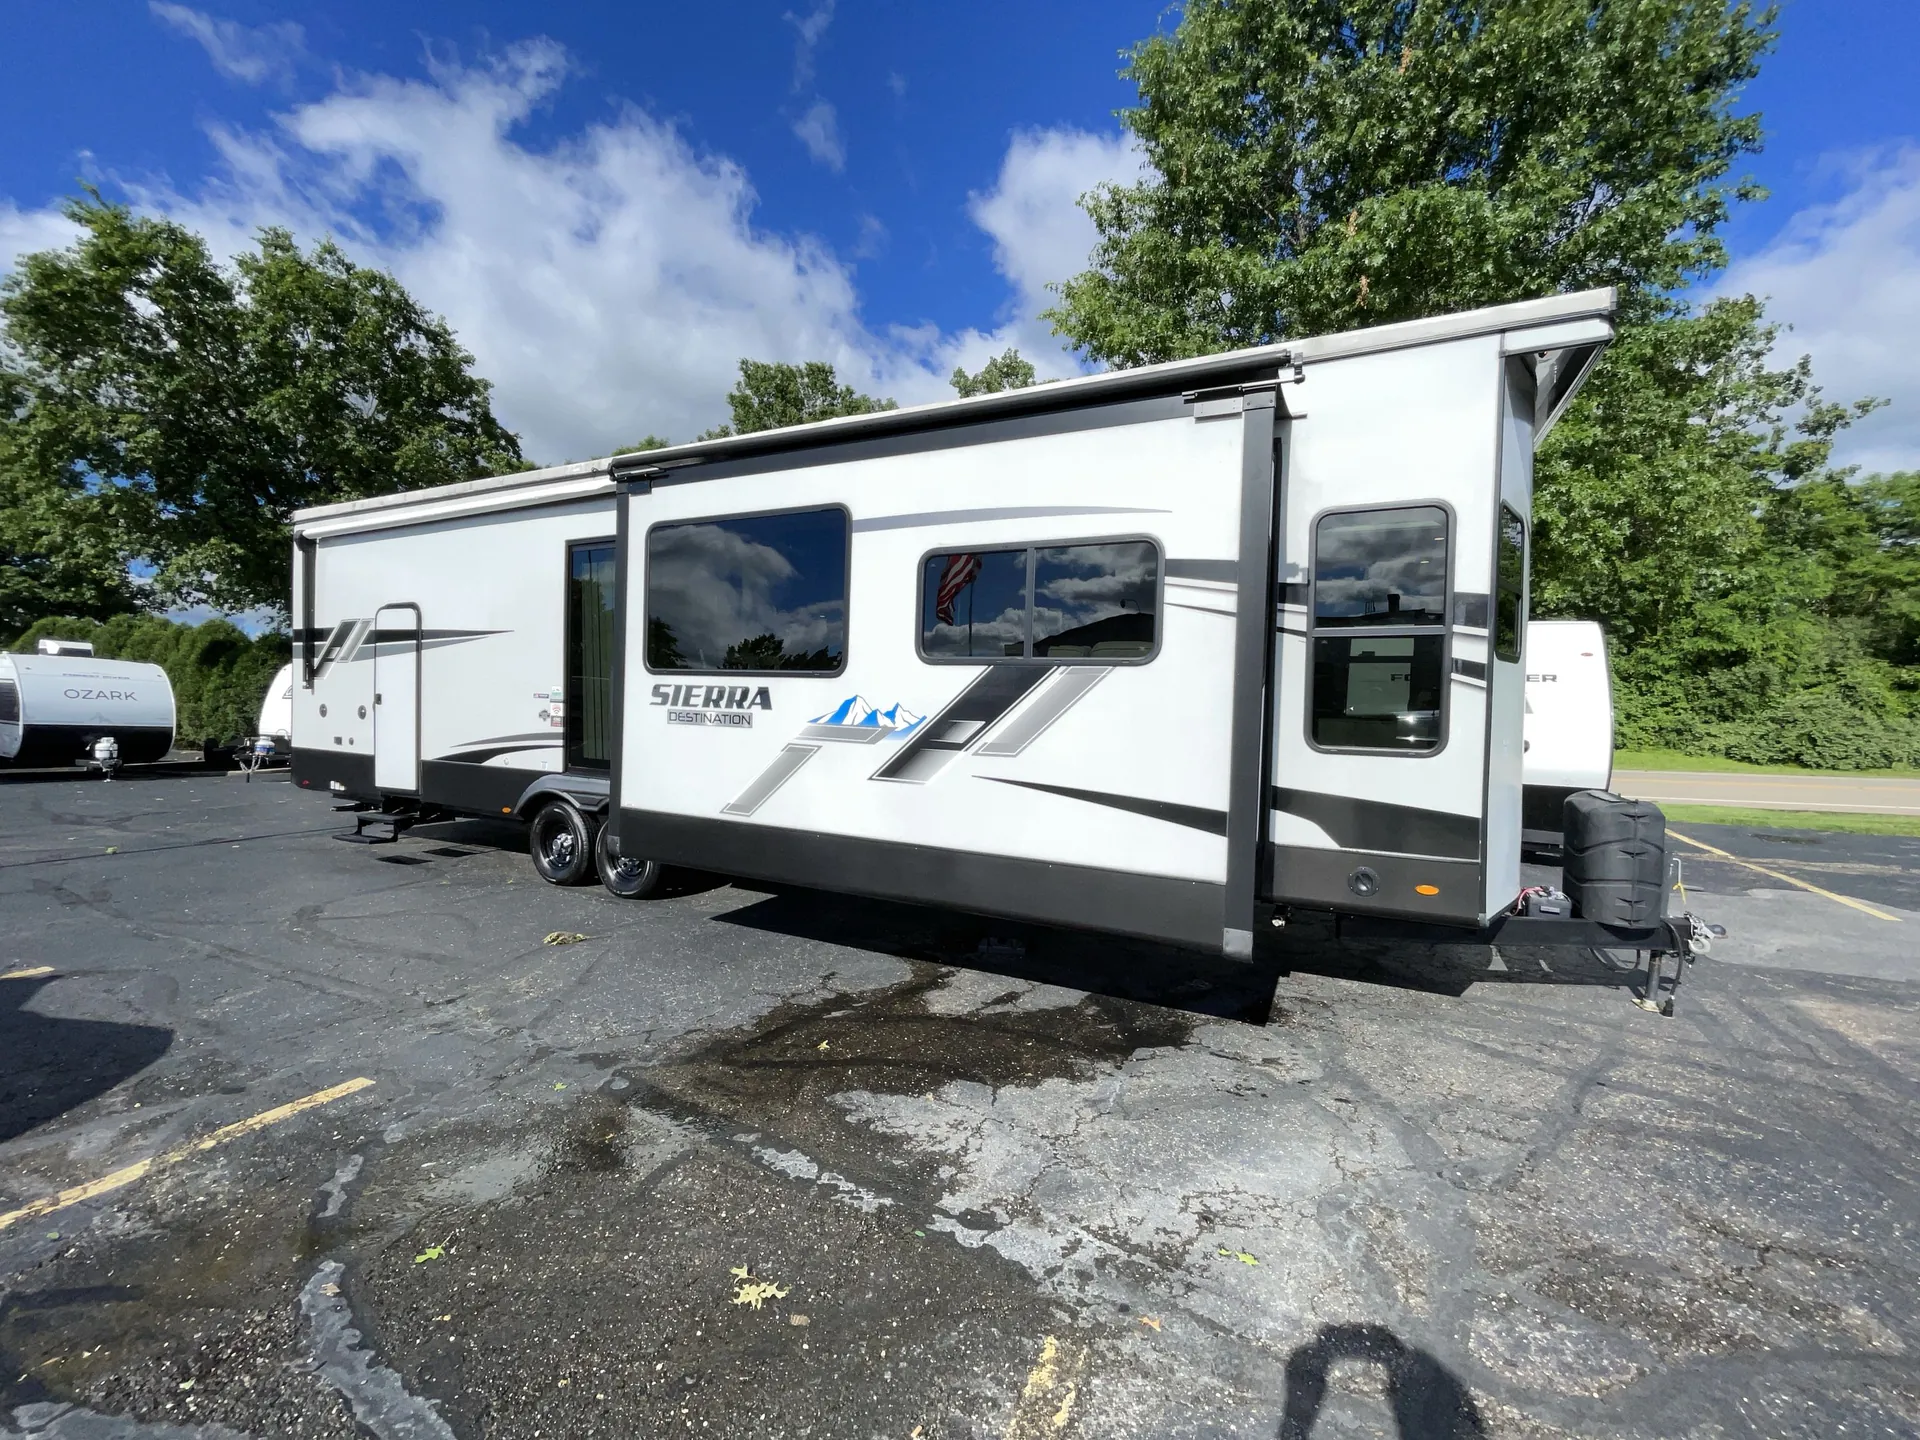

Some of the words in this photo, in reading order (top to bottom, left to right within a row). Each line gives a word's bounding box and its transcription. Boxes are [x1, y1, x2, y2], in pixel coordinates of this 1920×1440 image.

[64, 688, 138, 701] OZARK
[649, 684, 772, 710] SIERRA
[669, 711, 751, 725] DESTINATION
